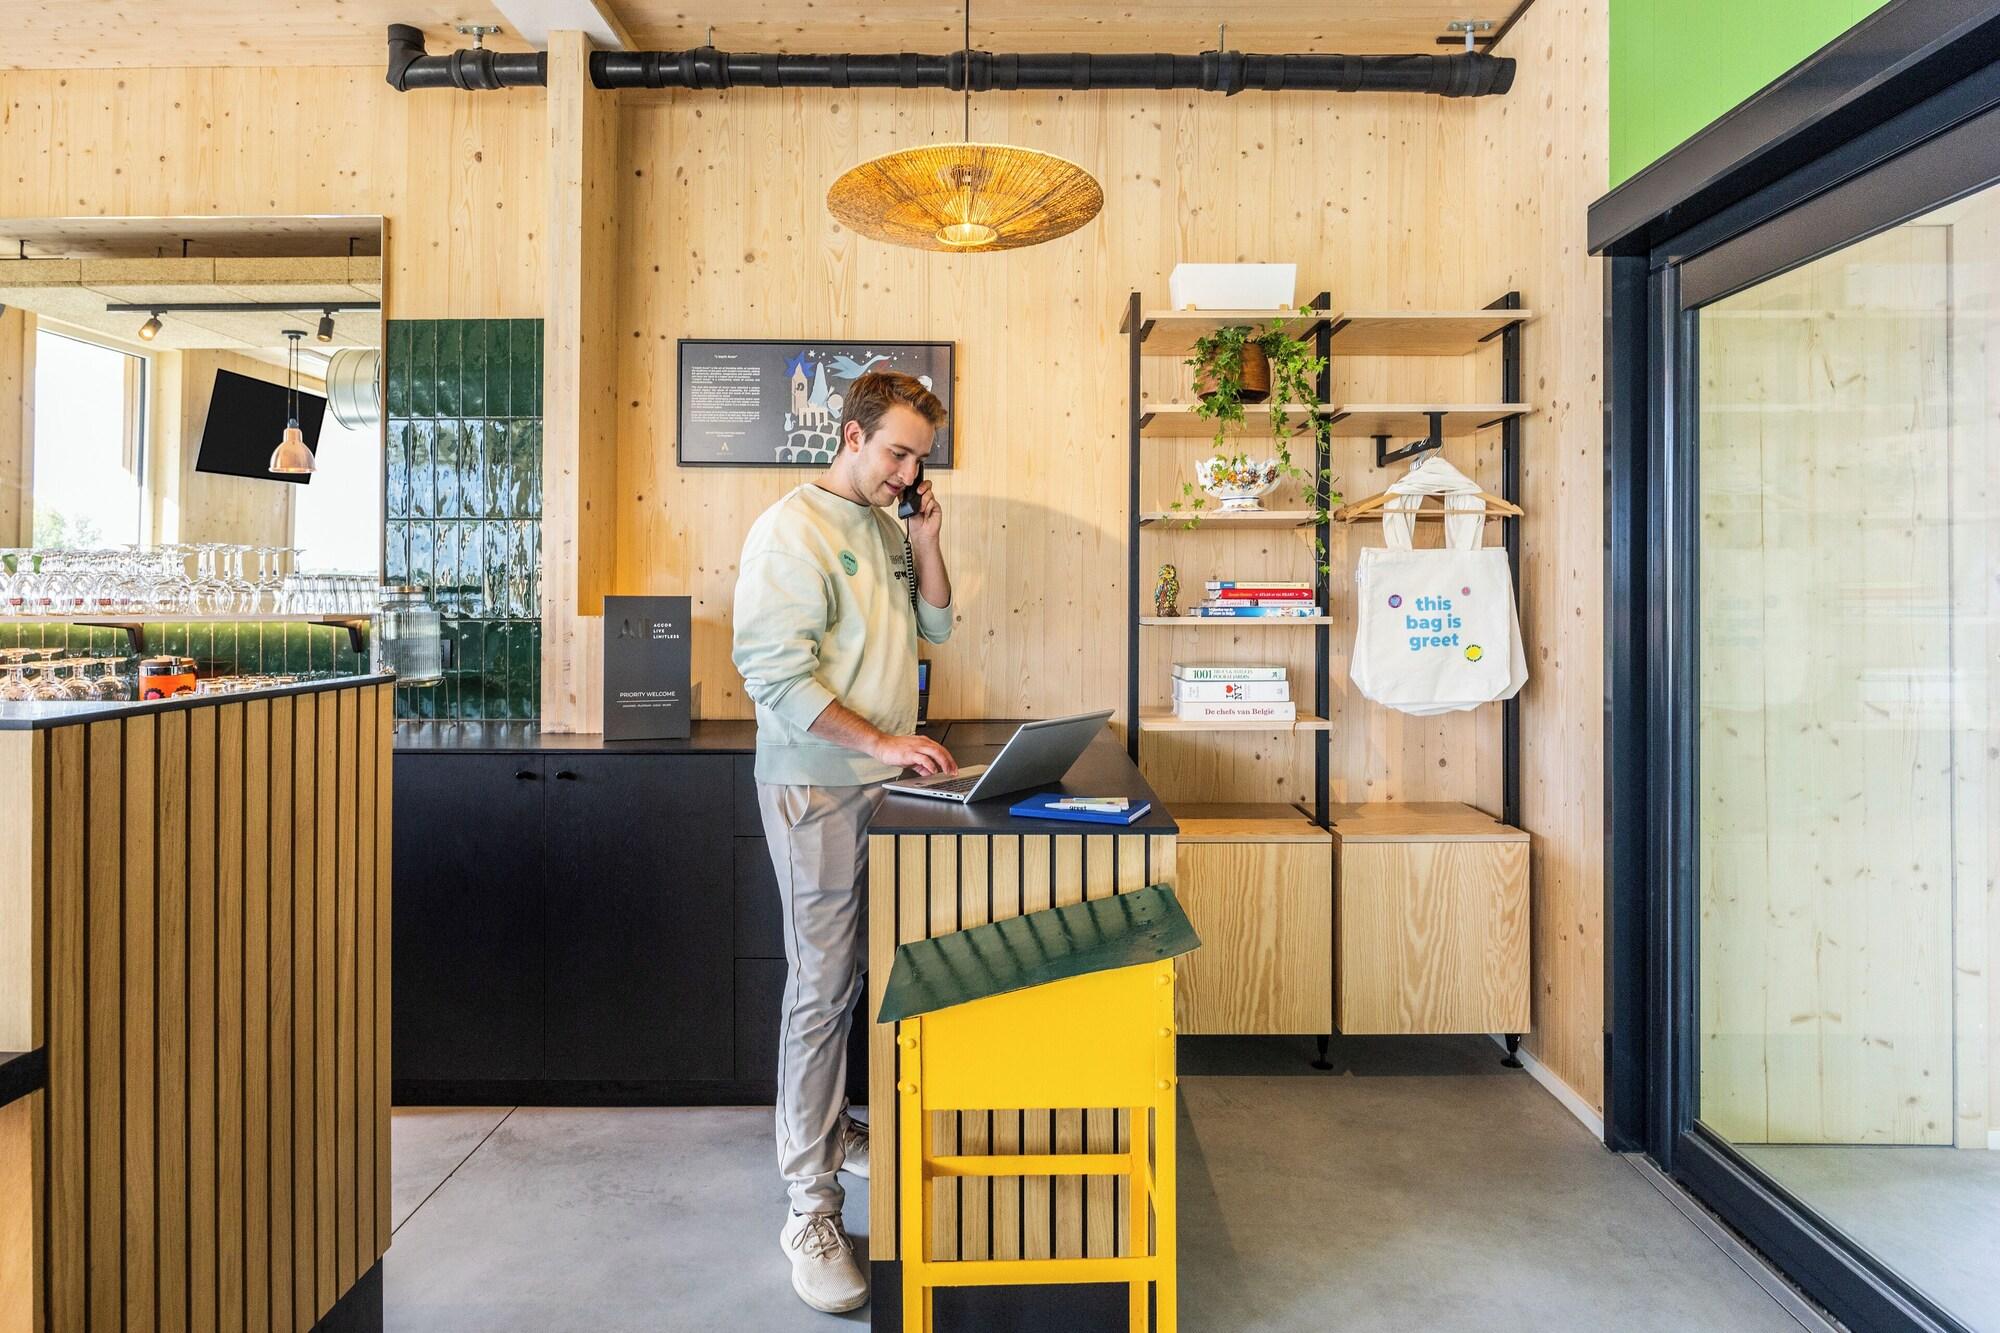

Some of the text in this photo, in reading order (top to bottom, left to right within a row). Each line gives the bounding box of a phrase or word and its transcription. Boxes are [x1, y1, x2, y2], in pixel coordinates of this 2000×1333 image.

[1415, 595, 1452, 611] this
[1406, 613, 1462, 632] bag is
[1409, 633, 1459, 651] greet
[1193, 669, 1212, 679] 1001
[1234, 683, 1243, 700] NY
[1216, 707, 1236, 715] chefs
